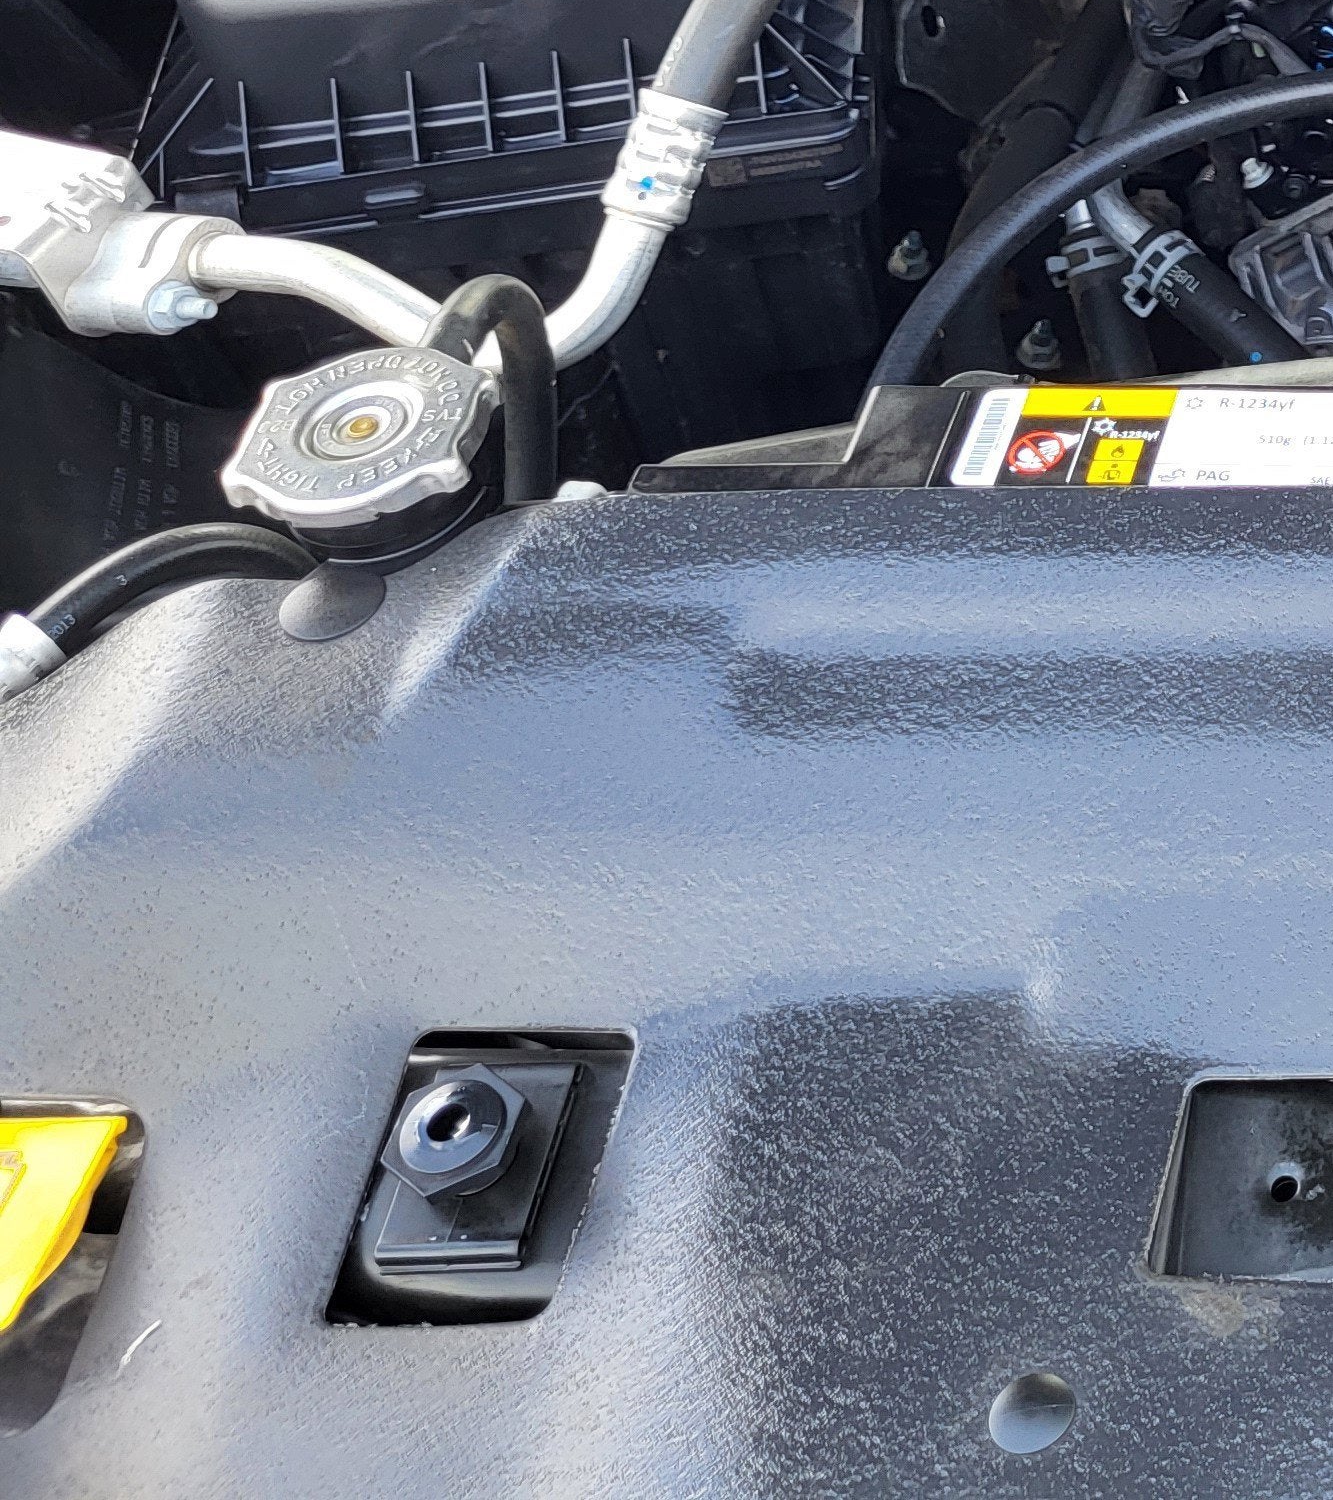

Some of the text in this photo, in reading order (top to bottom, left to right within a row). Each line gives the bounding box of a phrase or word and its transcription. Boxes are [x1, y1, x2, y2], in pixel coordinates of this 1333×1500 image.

[327, 354, 405, 382] OPEN
[1219, 397, 1296, 412] R-1234yf
[421, 407, 463, 422] TVS
[1196, 469, 1232, 482] PAG
